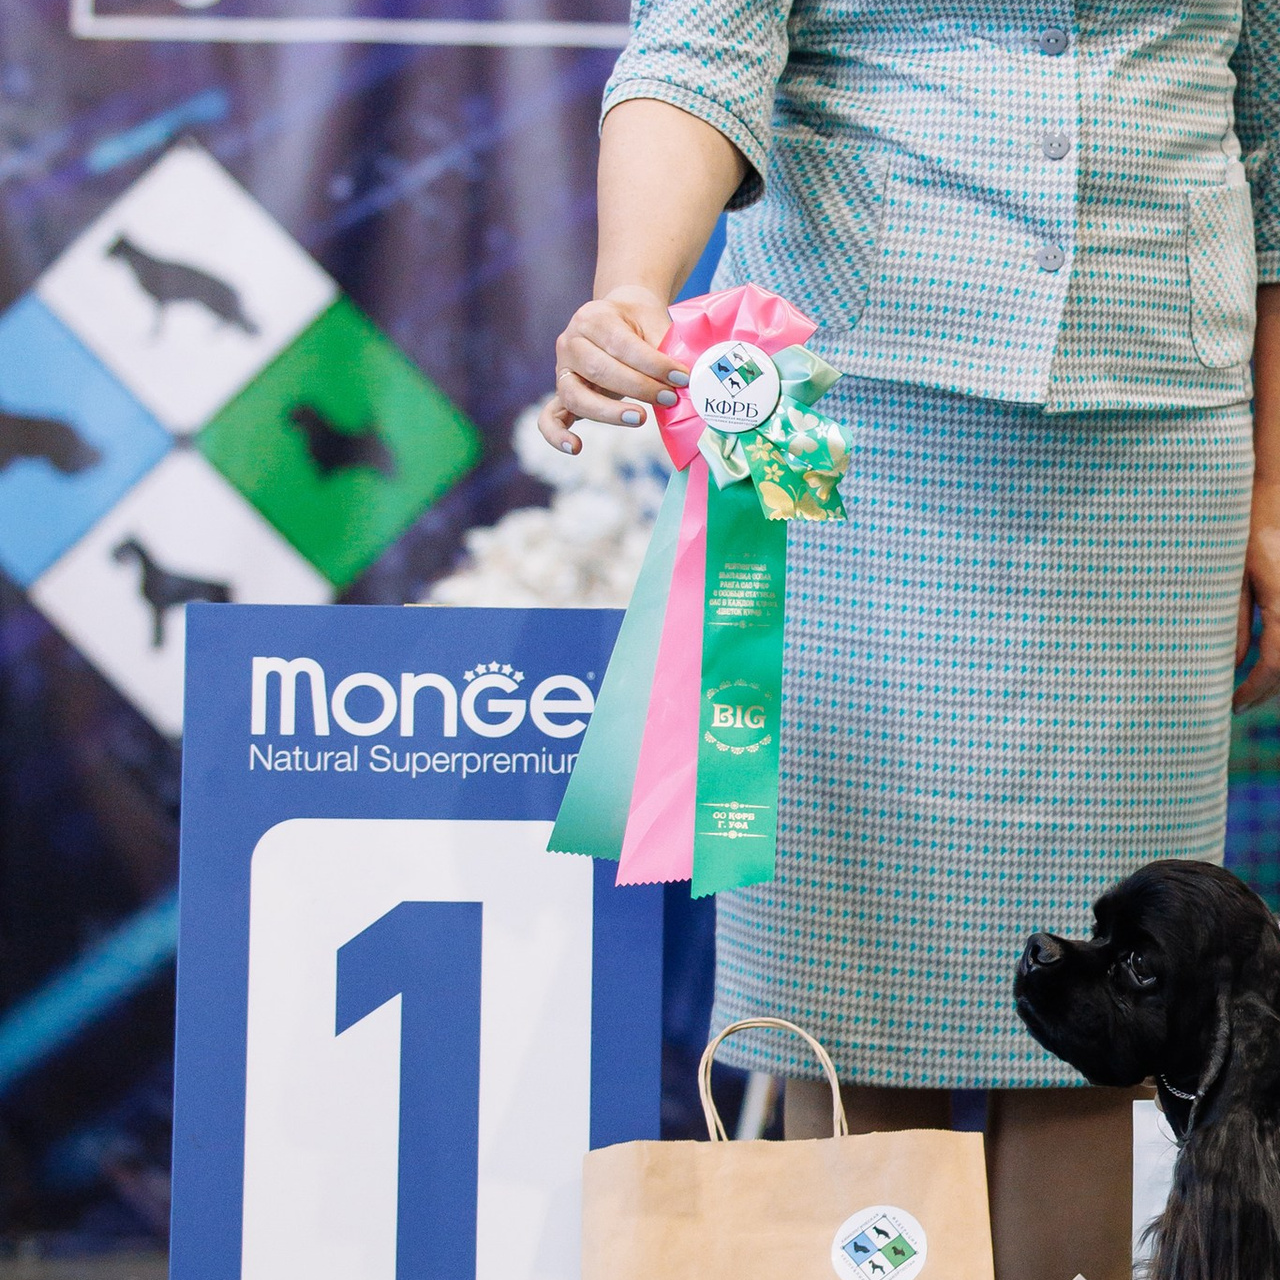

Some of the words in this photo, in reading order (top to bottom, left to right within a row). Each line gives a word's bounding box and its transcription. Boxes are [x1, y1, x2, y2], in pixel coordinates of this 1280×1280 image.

[704, 397, 759, 419] КФРБ
[711, 703, 767, 729] BIG
[249, 743, 359, 772] Natural
